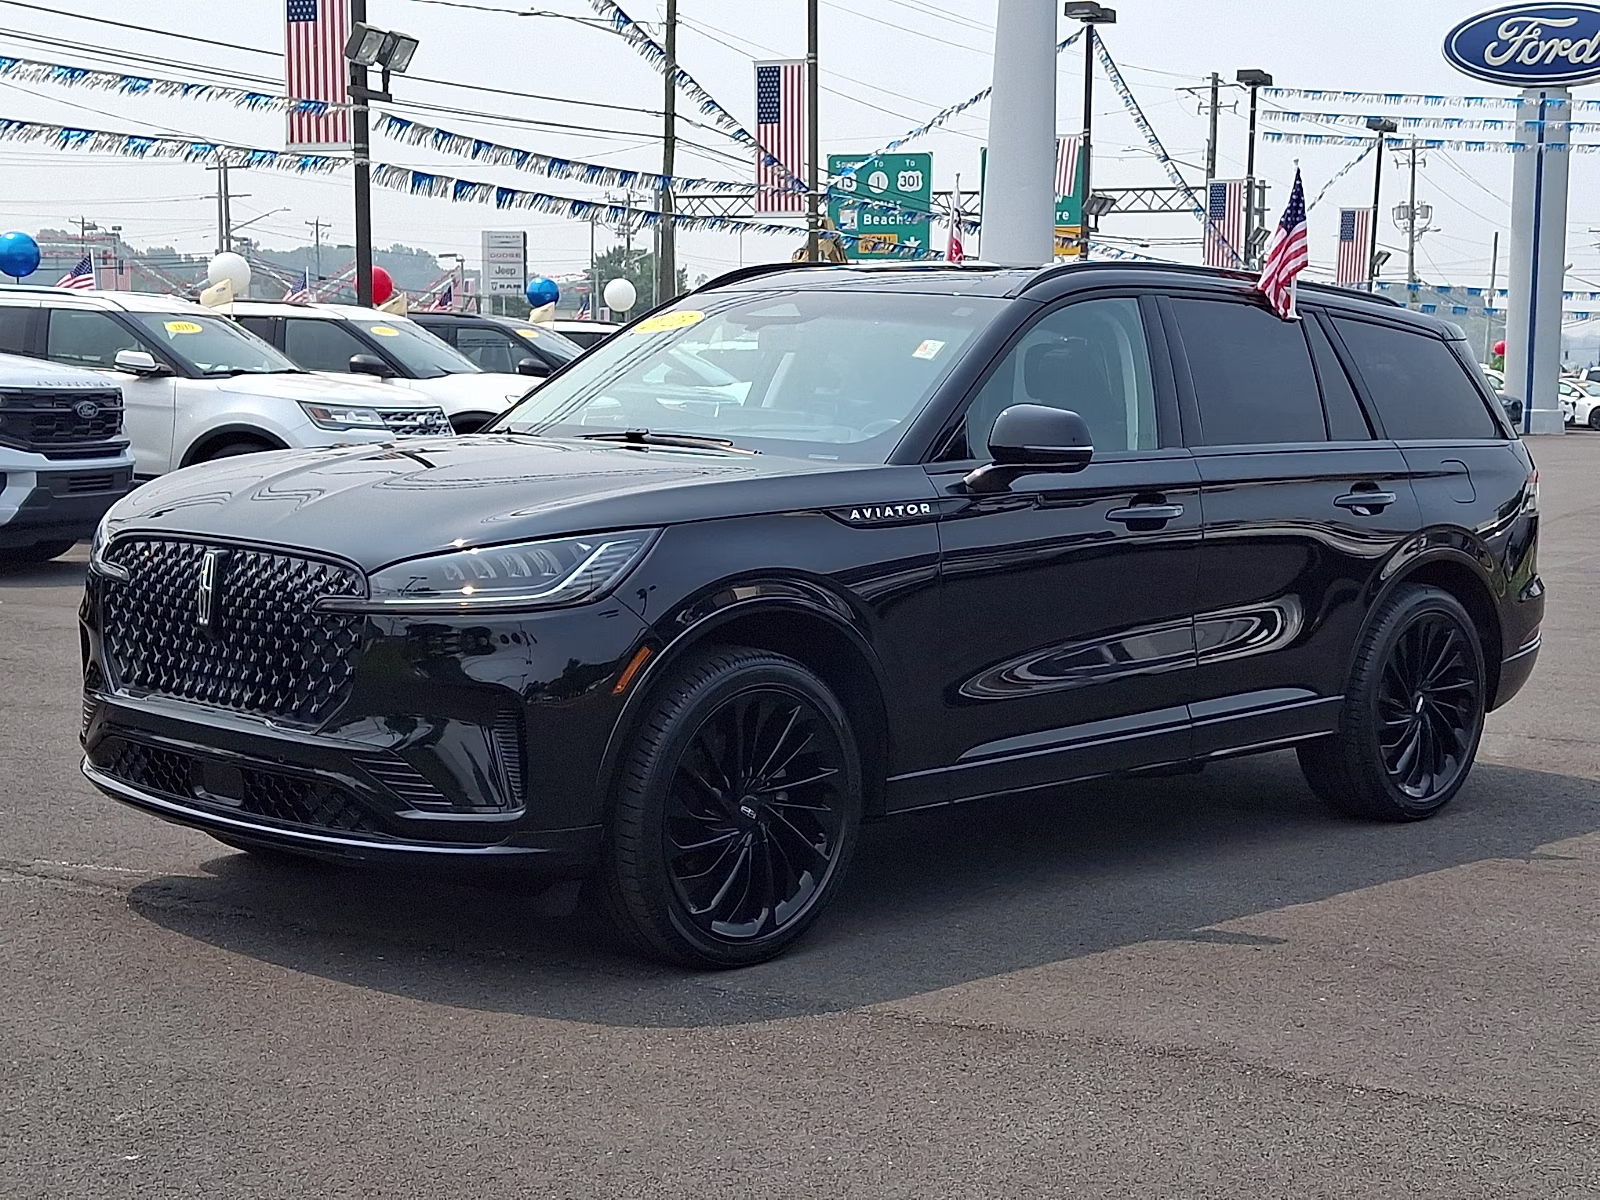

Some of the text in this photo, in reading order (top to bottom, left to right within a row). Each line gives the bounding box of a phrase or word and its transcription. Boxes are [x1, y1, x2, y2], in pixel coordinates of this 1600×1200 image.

[1484, 16, 1600, 66] Ford
[874, 160, 884, 168] To
[899, 175, 920, 188] 301
[495, 265, 516, 277] Jeep
[850, 503, 930, 520] AVIATOR
